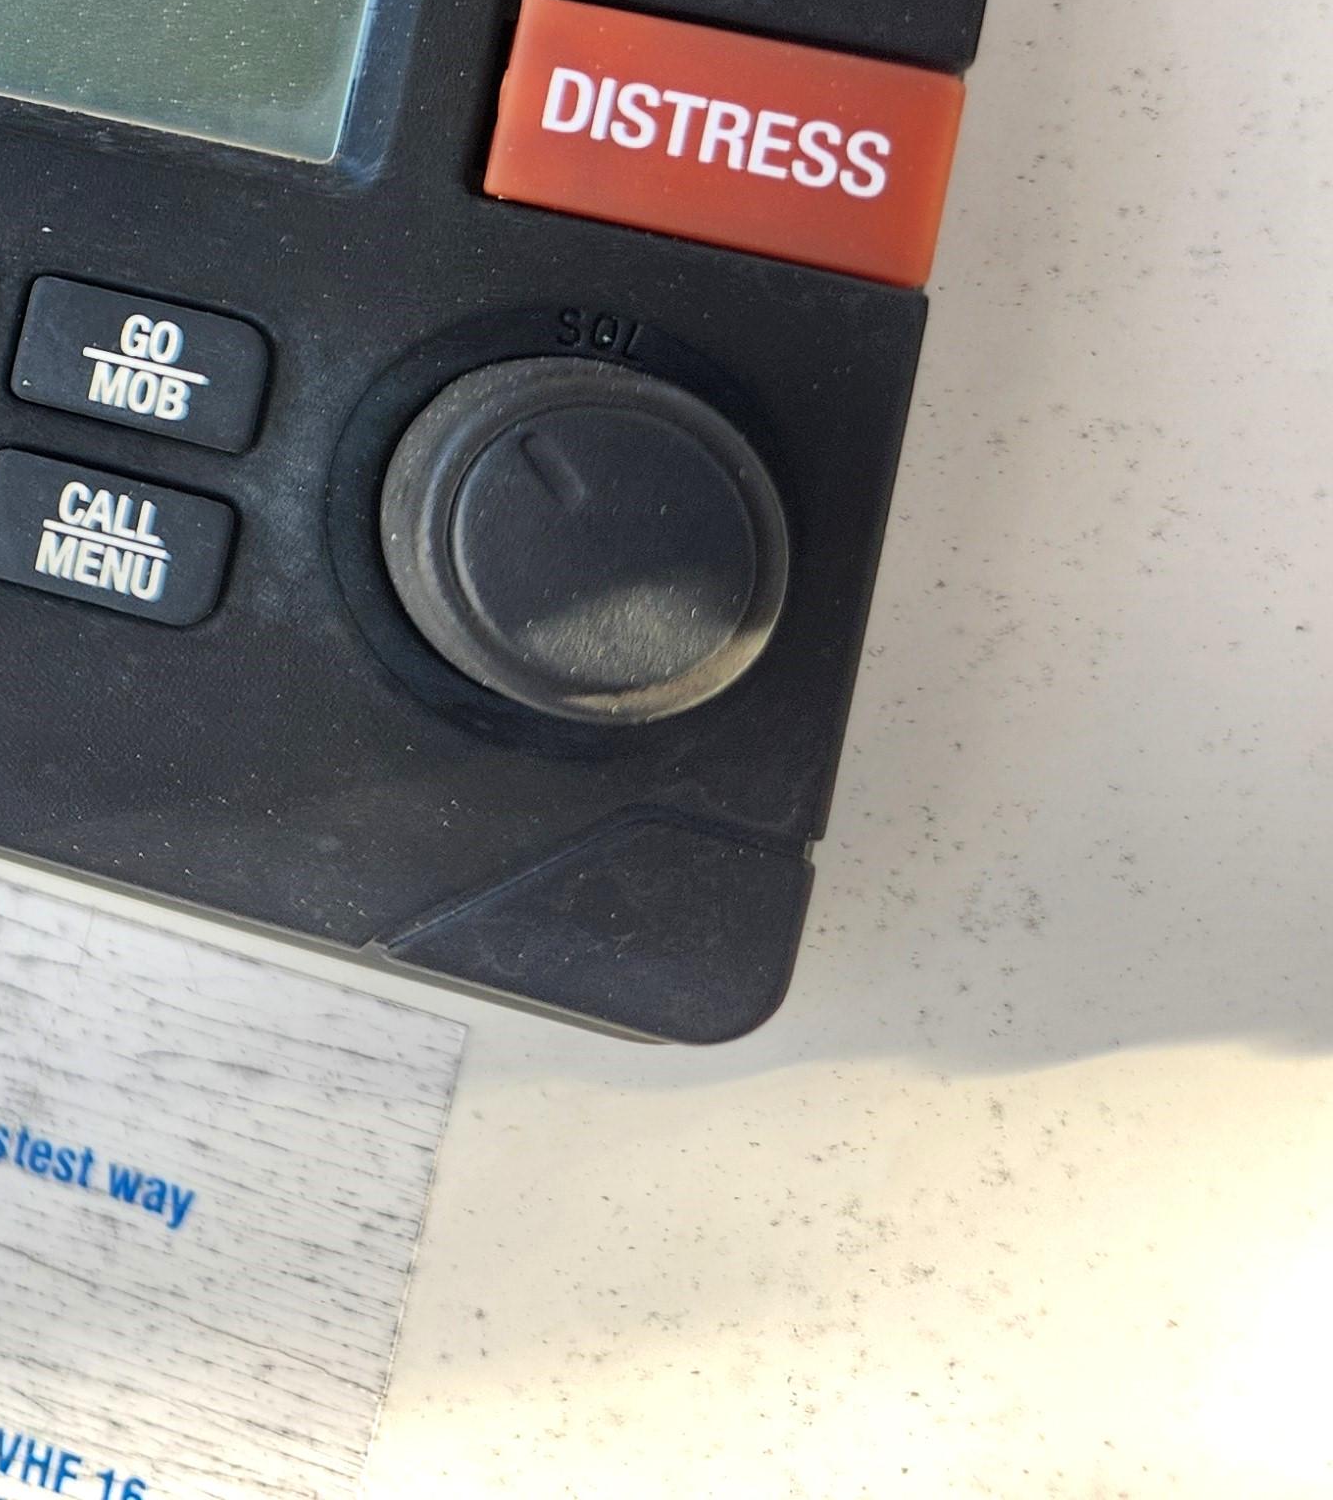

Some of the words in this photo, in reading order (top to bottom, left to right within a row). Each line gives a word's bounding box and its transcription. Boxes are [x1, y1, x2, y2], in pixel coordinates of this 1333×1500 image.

[541, 68, 892, 198] DISTRESS
[119, 314, 185, 366] GO
[89, 362, 191, 423] MOB
[57, 480, 163, 547] CALL
[33, 535, 169, 602] MENU
[107, 1160, 197, 1230] way
[95, 1467, 147, 1499] 16
